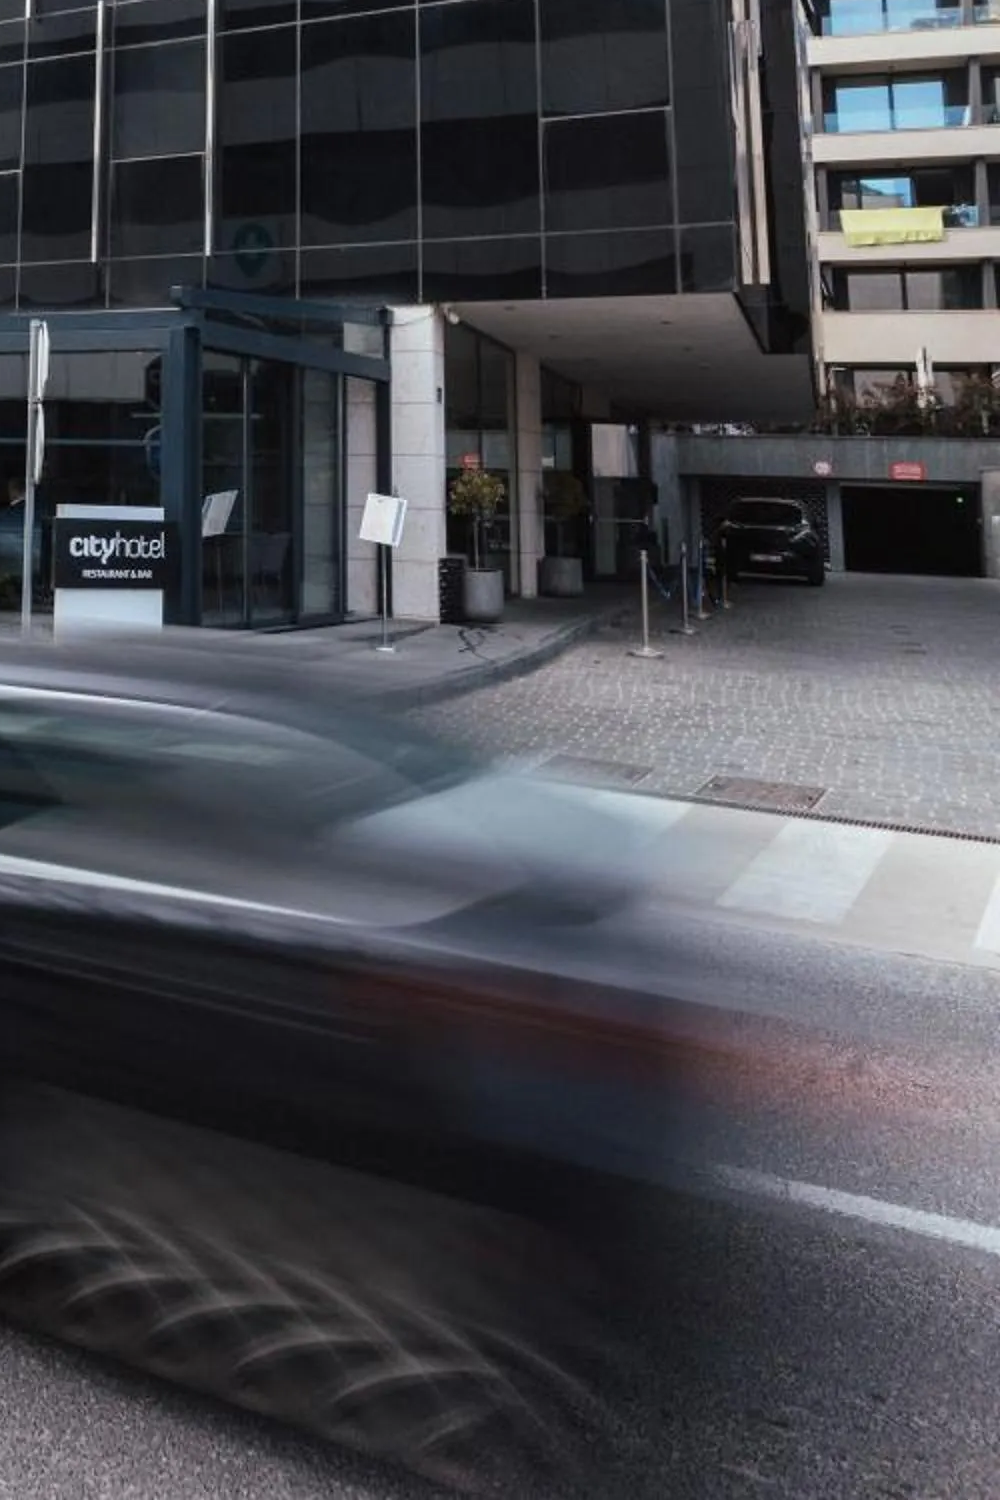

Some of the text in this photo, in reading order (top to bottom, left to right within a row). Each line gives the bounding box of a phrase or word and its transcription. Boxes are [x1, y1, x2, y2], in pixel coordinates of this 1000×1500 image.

[69, 531, 165, 565] cityhotel
[81, 569, 130, 578] RESTAURANT
[138, 569, 152, 579] BAR
